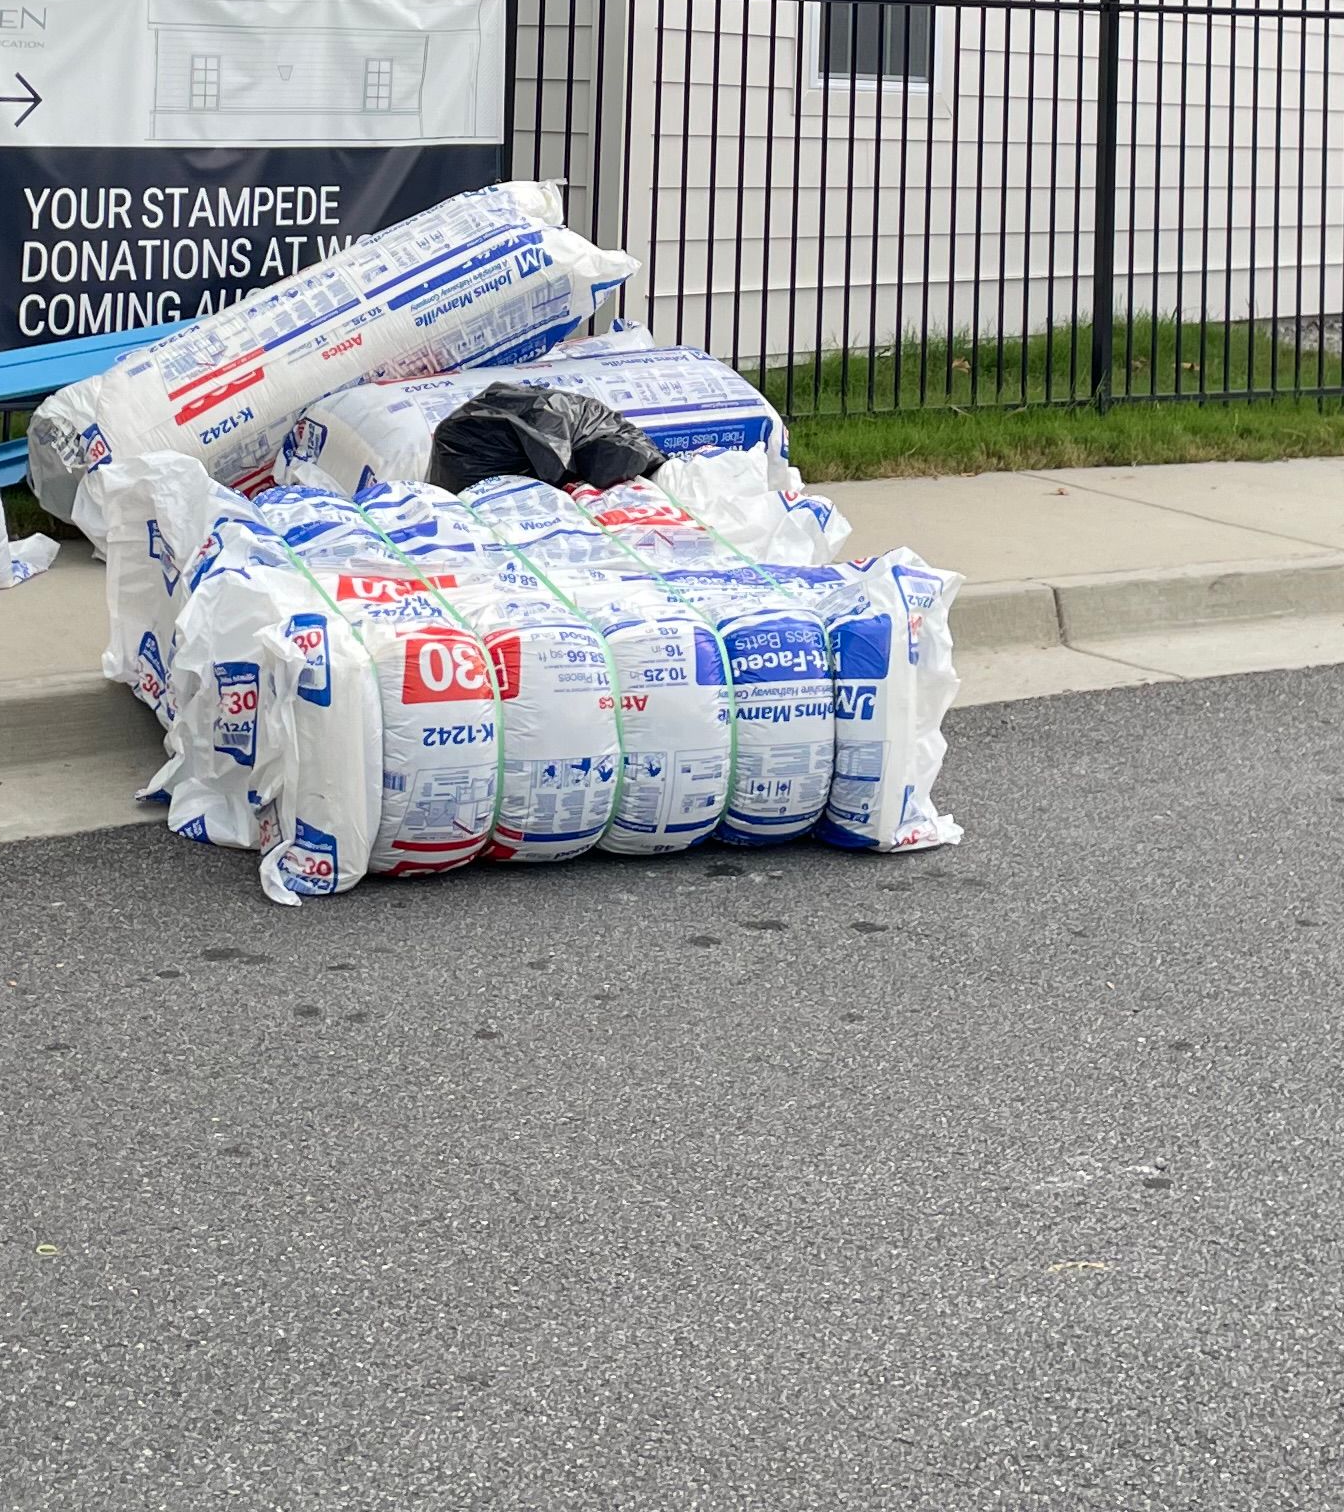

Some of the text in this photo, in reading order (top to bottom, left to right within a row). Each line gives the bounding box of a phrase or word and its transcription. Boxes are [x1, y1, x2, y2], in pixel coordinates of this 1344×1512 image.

[23, 187, 133, 231] YOUR
[141, 185, 341, 229] STAMPEDE
[20, 237, 253, 284] DONATIONS
[259, 236, 308, 277] AT
[413, 271, 514, 329] Johns Manville
[18, 291, 181, 338] COMING
[321, 332, 364, 363] Attics
[199, 407, 256, 446] K-1242
[664, 430, 746, 450] Fiber Glass Batts
[519, 517, 561, 531] Wood
[734, 632, 782, 651] Batts
[536, 652, 548, 663] ft
[558, 672, 610, 686] 11 Pieces
[751, 687, 799, 698] Hathaway
[421, 723, 495, 748] K-1242
